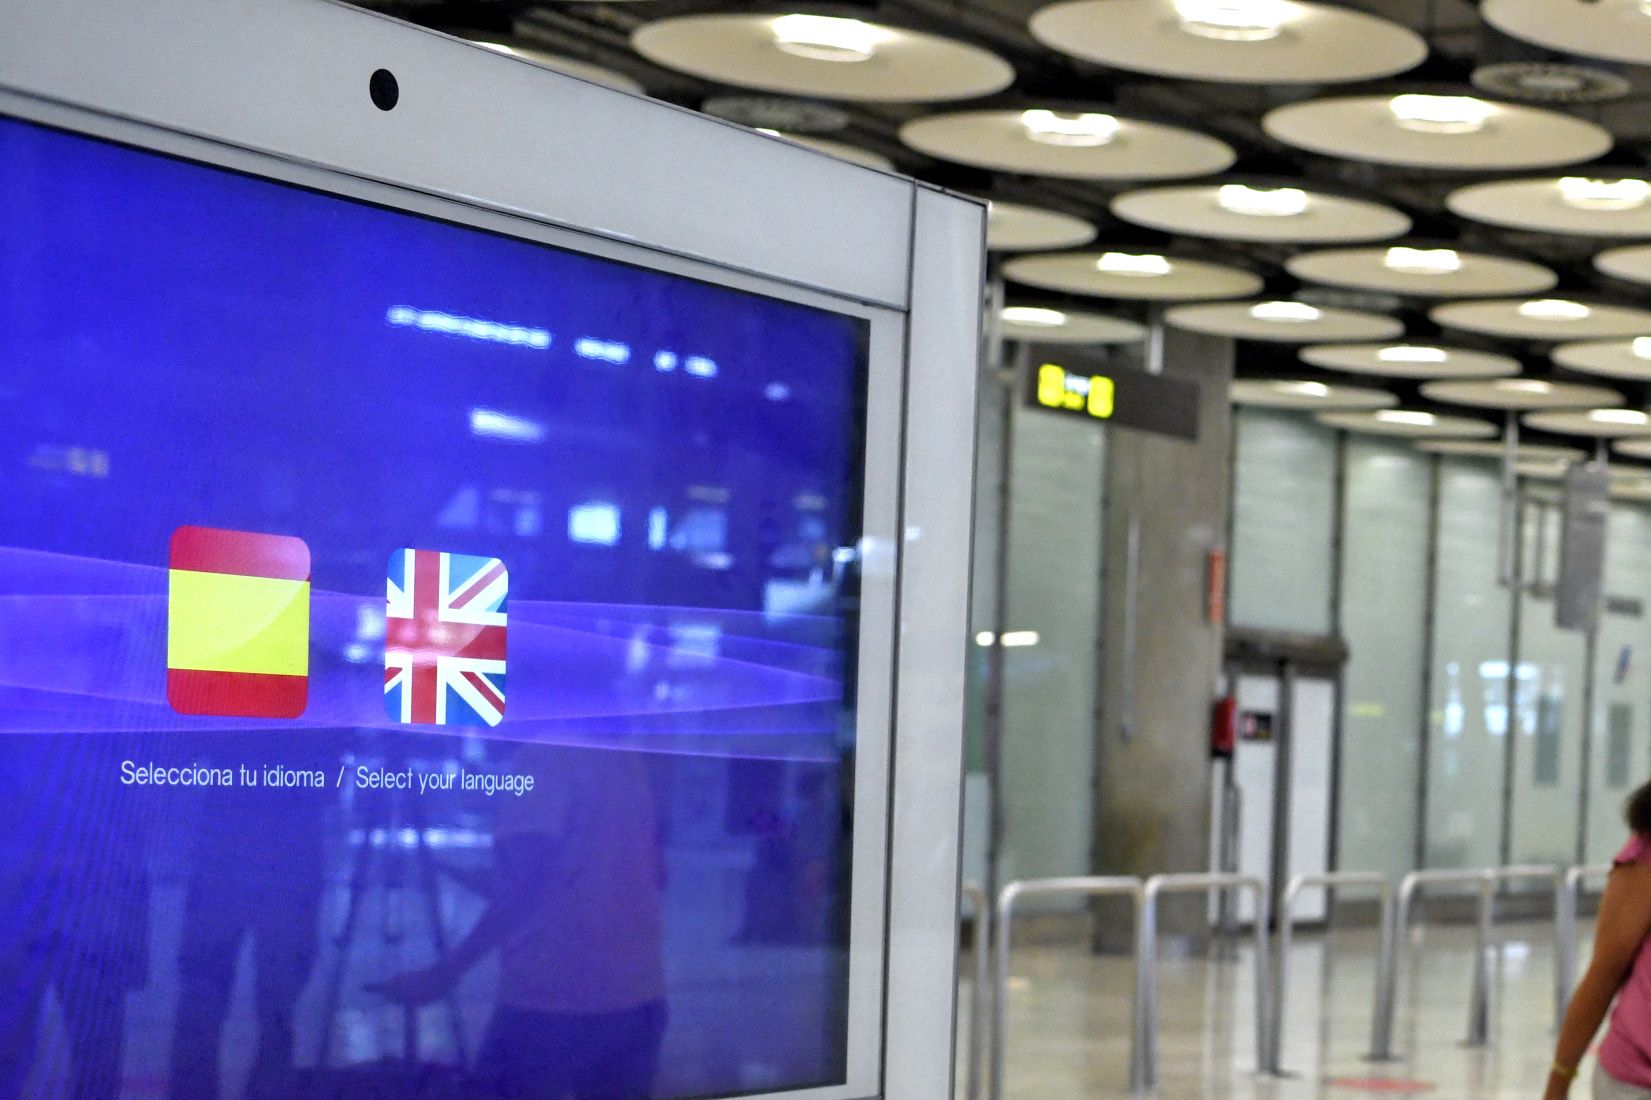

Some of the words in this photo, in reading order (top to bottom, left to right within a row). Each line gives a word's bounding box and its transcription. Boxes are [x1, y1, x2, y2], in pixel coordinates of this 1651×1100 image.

[120, 760, 233, 785] Selecciona
[239, 763, 257, 787] tu
[263, 764, 325, 788] idioma
[356, 765, 413, 789] Select
[418, 771, 456, 795] your
[461, 769, 535, 796] language
